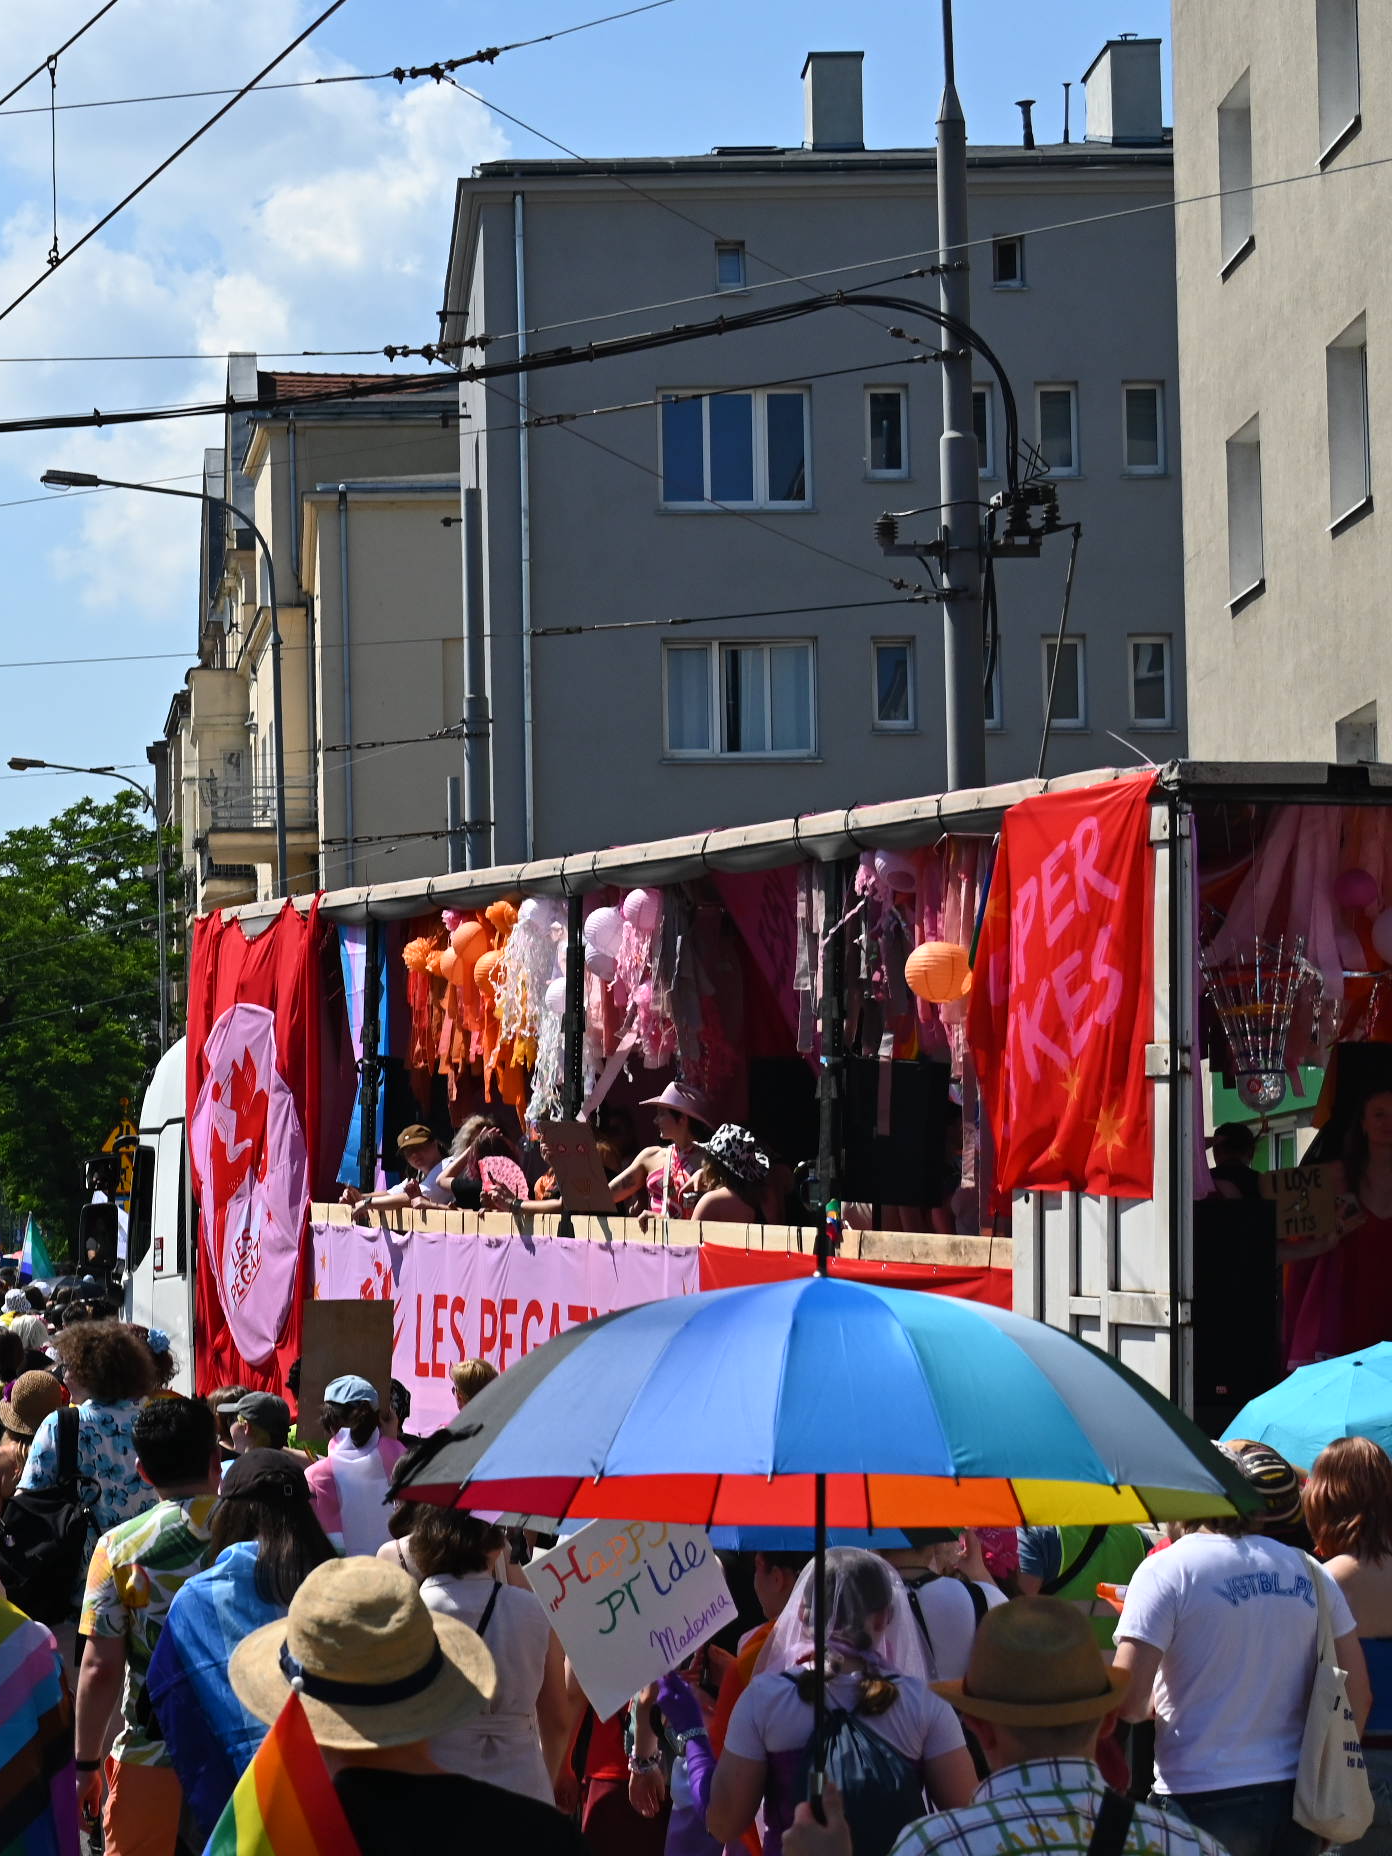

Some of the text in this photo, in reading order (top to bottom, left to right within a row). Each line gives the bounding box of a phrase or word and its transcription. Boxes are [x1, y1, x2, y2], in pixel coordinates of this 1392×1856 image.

[1284, 1167, 1322, 1192] LOVE
[1284, 1215, 1318, 1235] TITS
[415, 1293, 466, 1379] LES
[649, 1593, 729, 1665] Madonna
